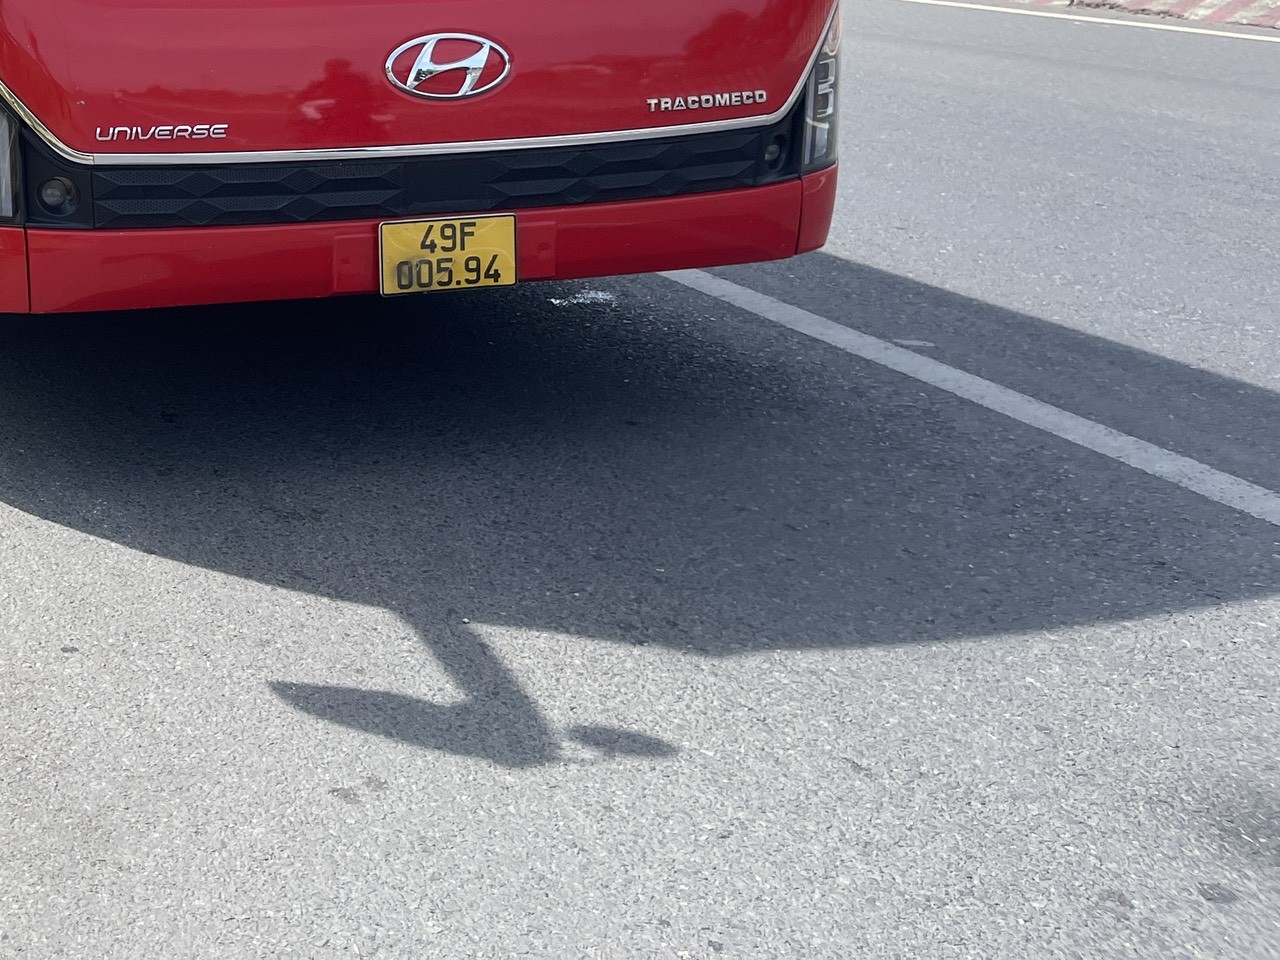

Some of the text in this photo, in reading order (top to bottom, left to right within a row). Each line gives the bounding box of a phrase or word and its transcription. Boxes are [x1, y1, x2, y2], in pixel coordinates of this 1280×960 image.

[646, 89, 767, 112] TRACOMECO
[95, 124, 229, 141] UNIVERSE
[420, 221, 477, 254] 49F
[396, 253, 501, 290] 005.94
